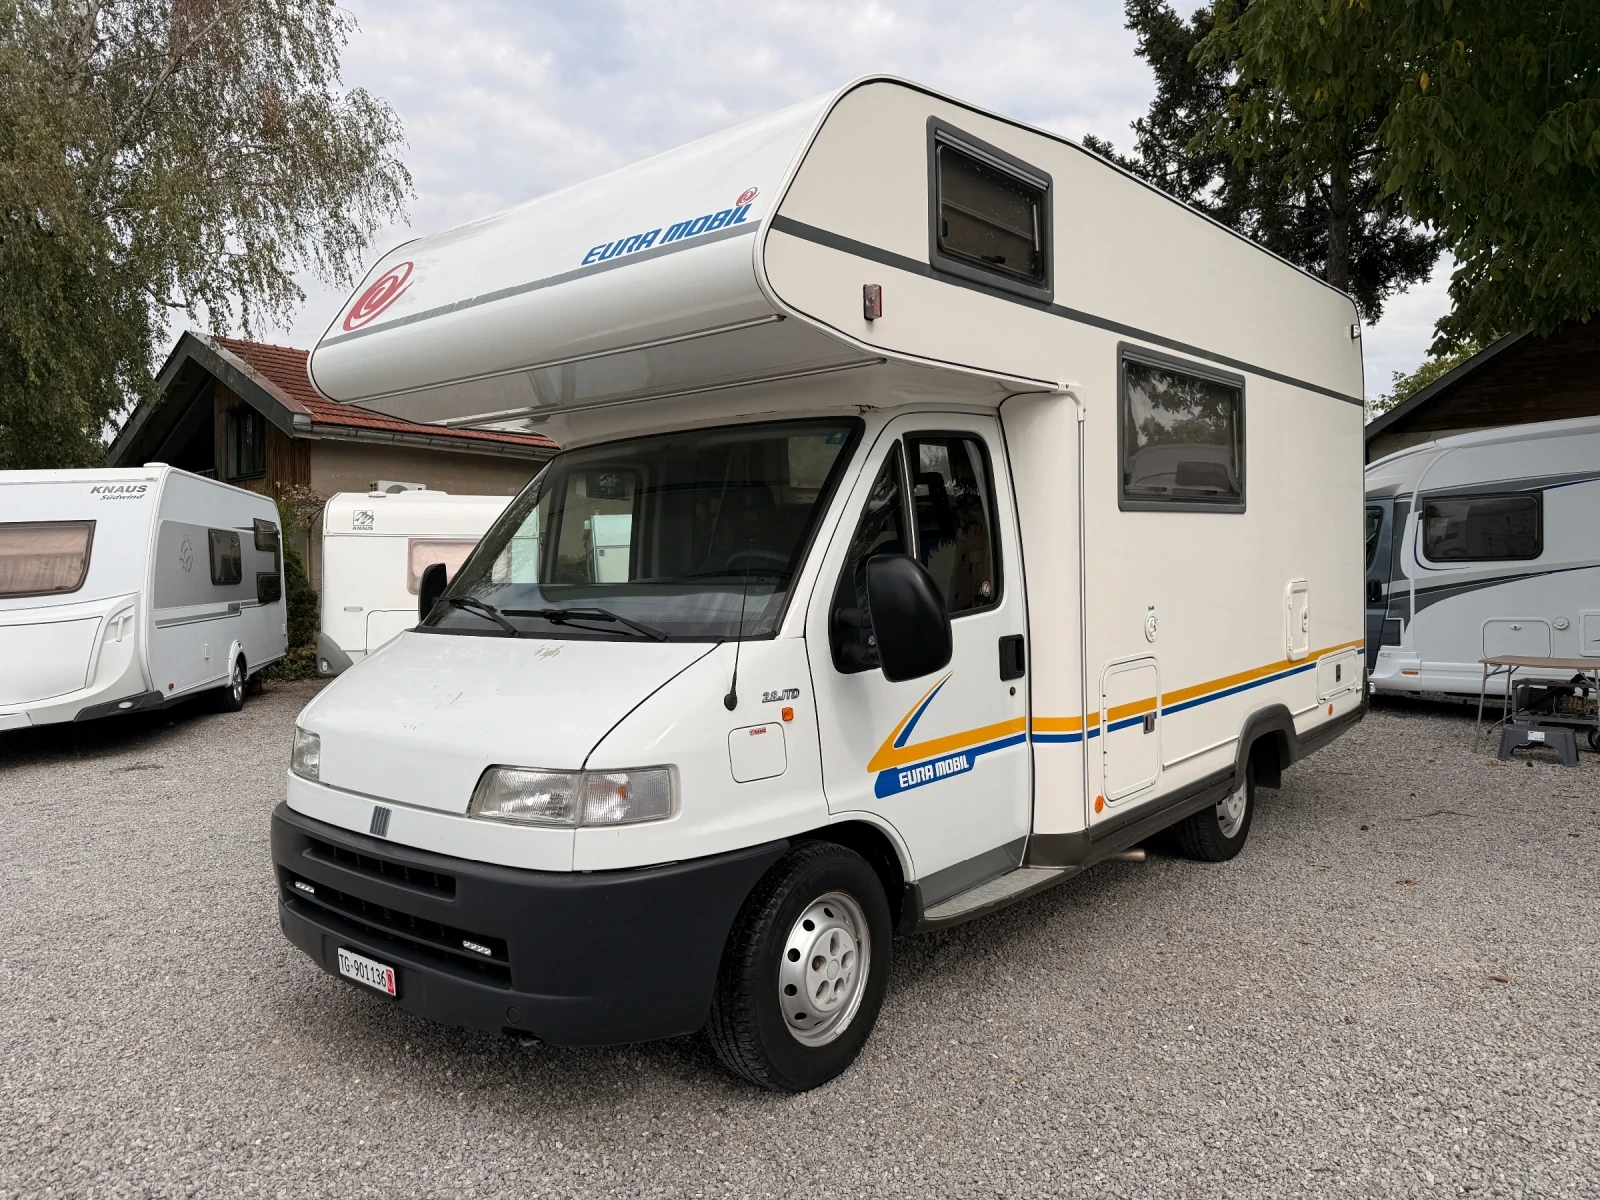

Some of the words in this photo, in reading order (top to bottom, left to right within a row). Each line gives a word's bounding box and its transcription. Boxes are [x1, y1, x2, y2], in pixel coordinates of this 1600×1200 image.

[581, 228, 663, 265] EURA
[659, 203, 753, 244] MOBIL
[90, 485, 148, 494] KNAUS
[898, 764, 934, 788] EURA
[935, 754, 970, 778] MOBIL
